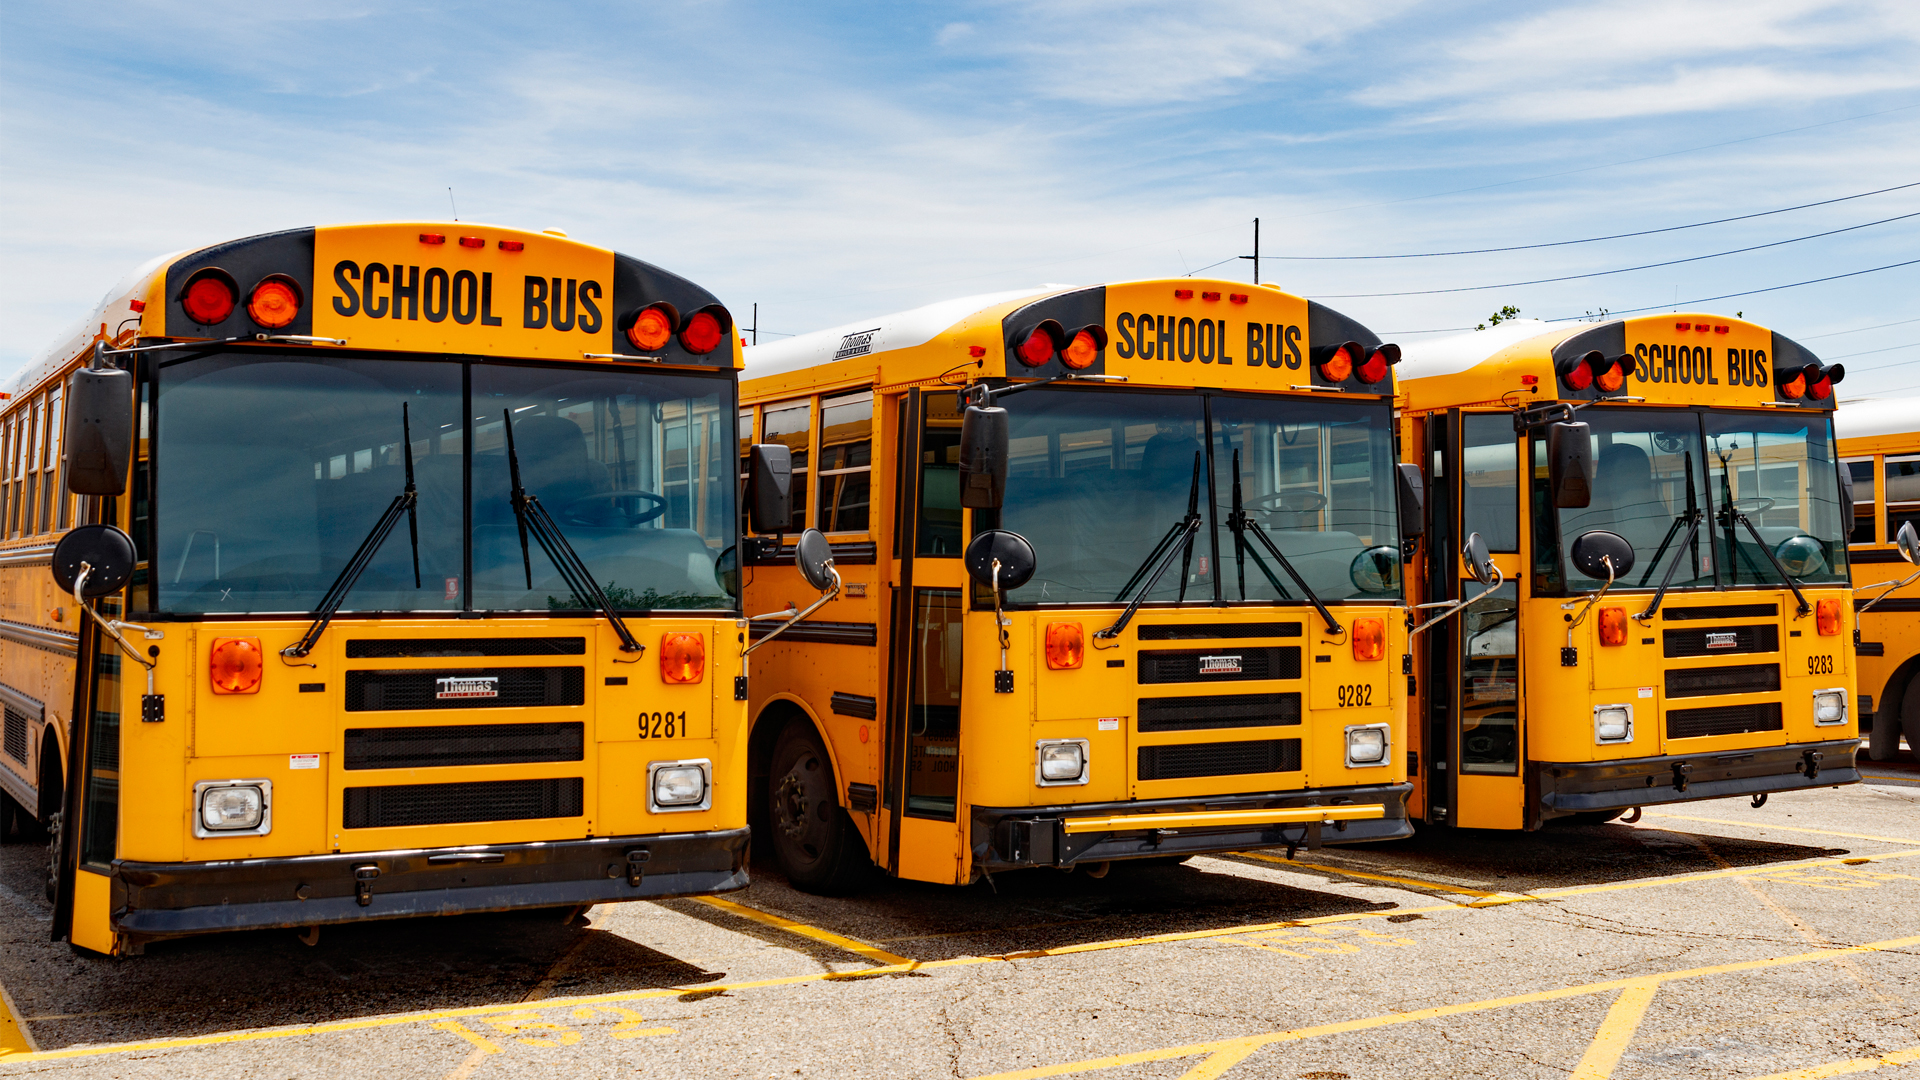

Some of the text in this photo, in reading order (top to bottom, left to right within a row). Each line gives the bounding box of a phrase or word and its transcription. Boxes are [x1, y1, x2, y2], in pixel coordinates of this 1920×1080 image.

[332, 260, 603, 335] SCHOOL BUS
[840, 327, 882, 350] Thomas
[1116, 312, 1302, 370] SCHOOL BUS
[1634, 343, 1768, 388] SCHOOL BUS
[1200, 655, 1241, 669] Thomas
[1808, 655, 1833, 675] 9283
[437, 677, 498, 692] Thomas
[1338, 684, 1372, 708] 9282
[638, 711, 686, 739] 9281
[429, 1006, 680, 1055] 152
